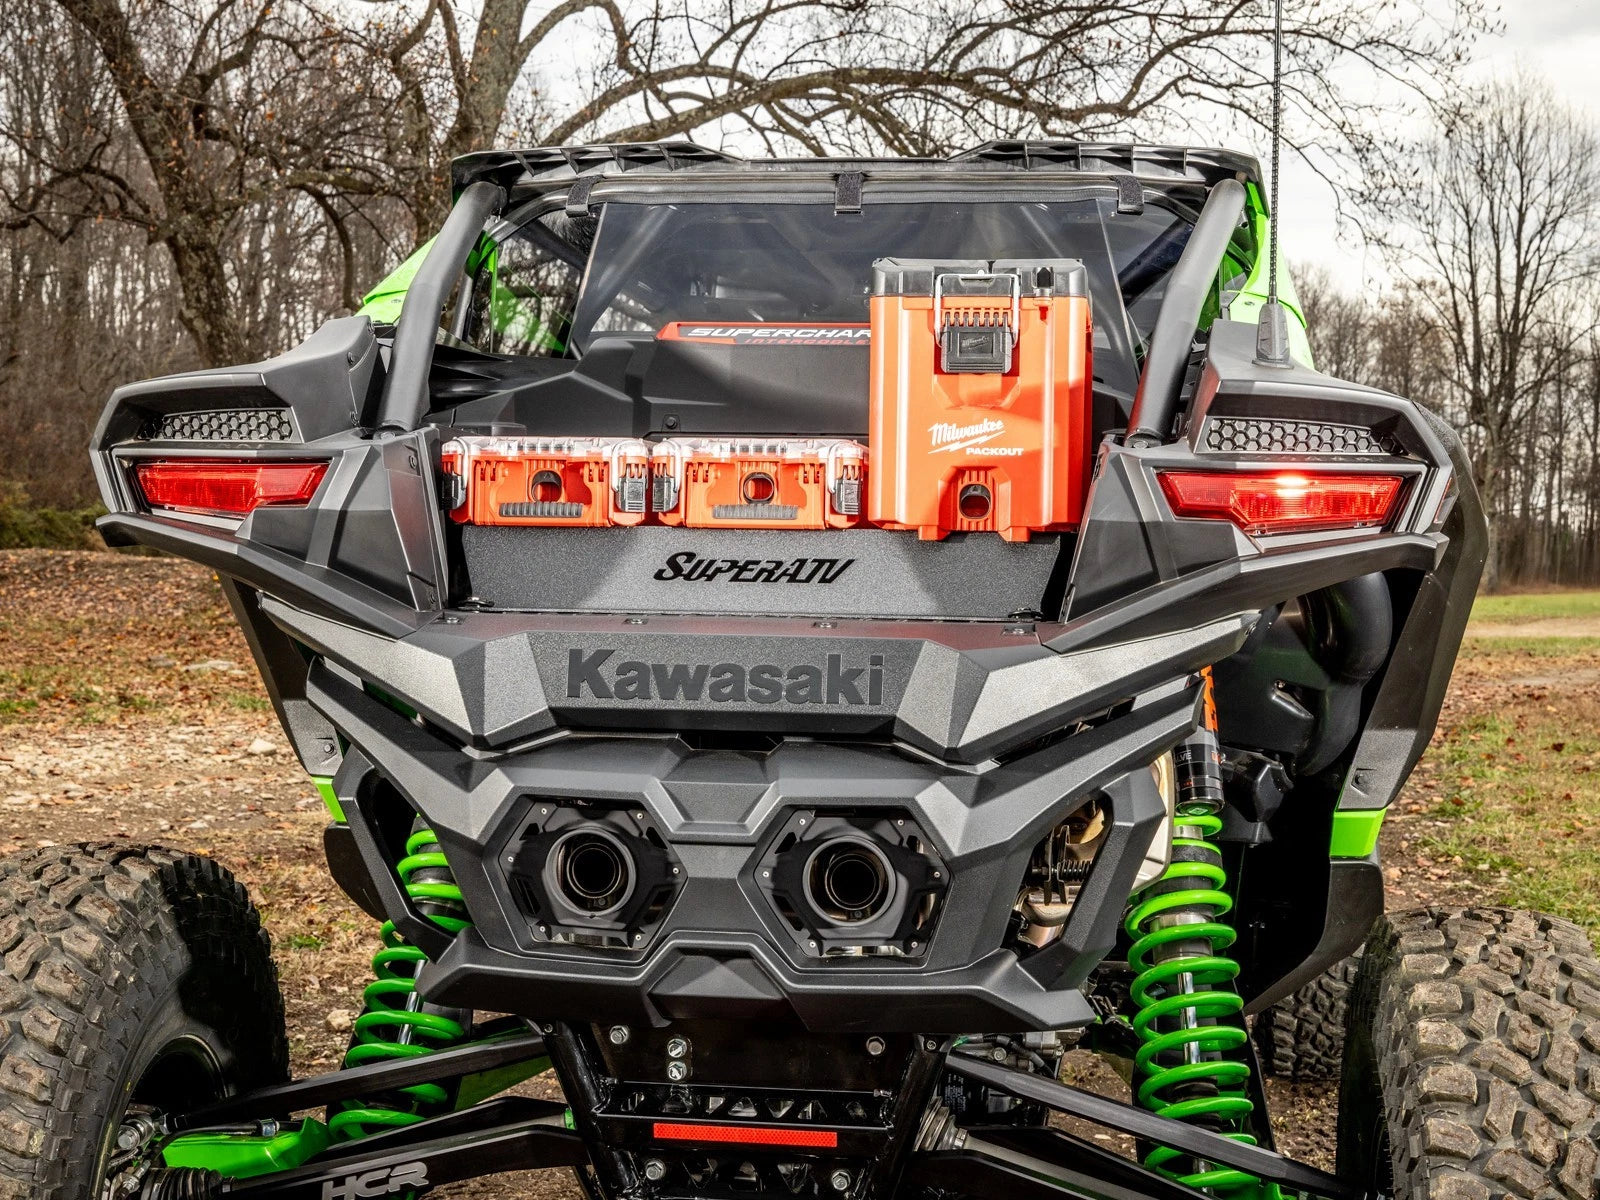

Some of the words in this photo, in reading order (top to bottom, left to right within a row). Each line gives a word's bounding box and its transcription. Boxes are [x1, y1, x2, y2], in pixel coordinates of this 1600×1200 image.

[928, 418, 1004, 446] Milwaukee
[966, 447, 1024, 456] PACKOUT
[566, 648, 884, 705] Kawasaki
[322, 1161, 429, 1200] HCR
